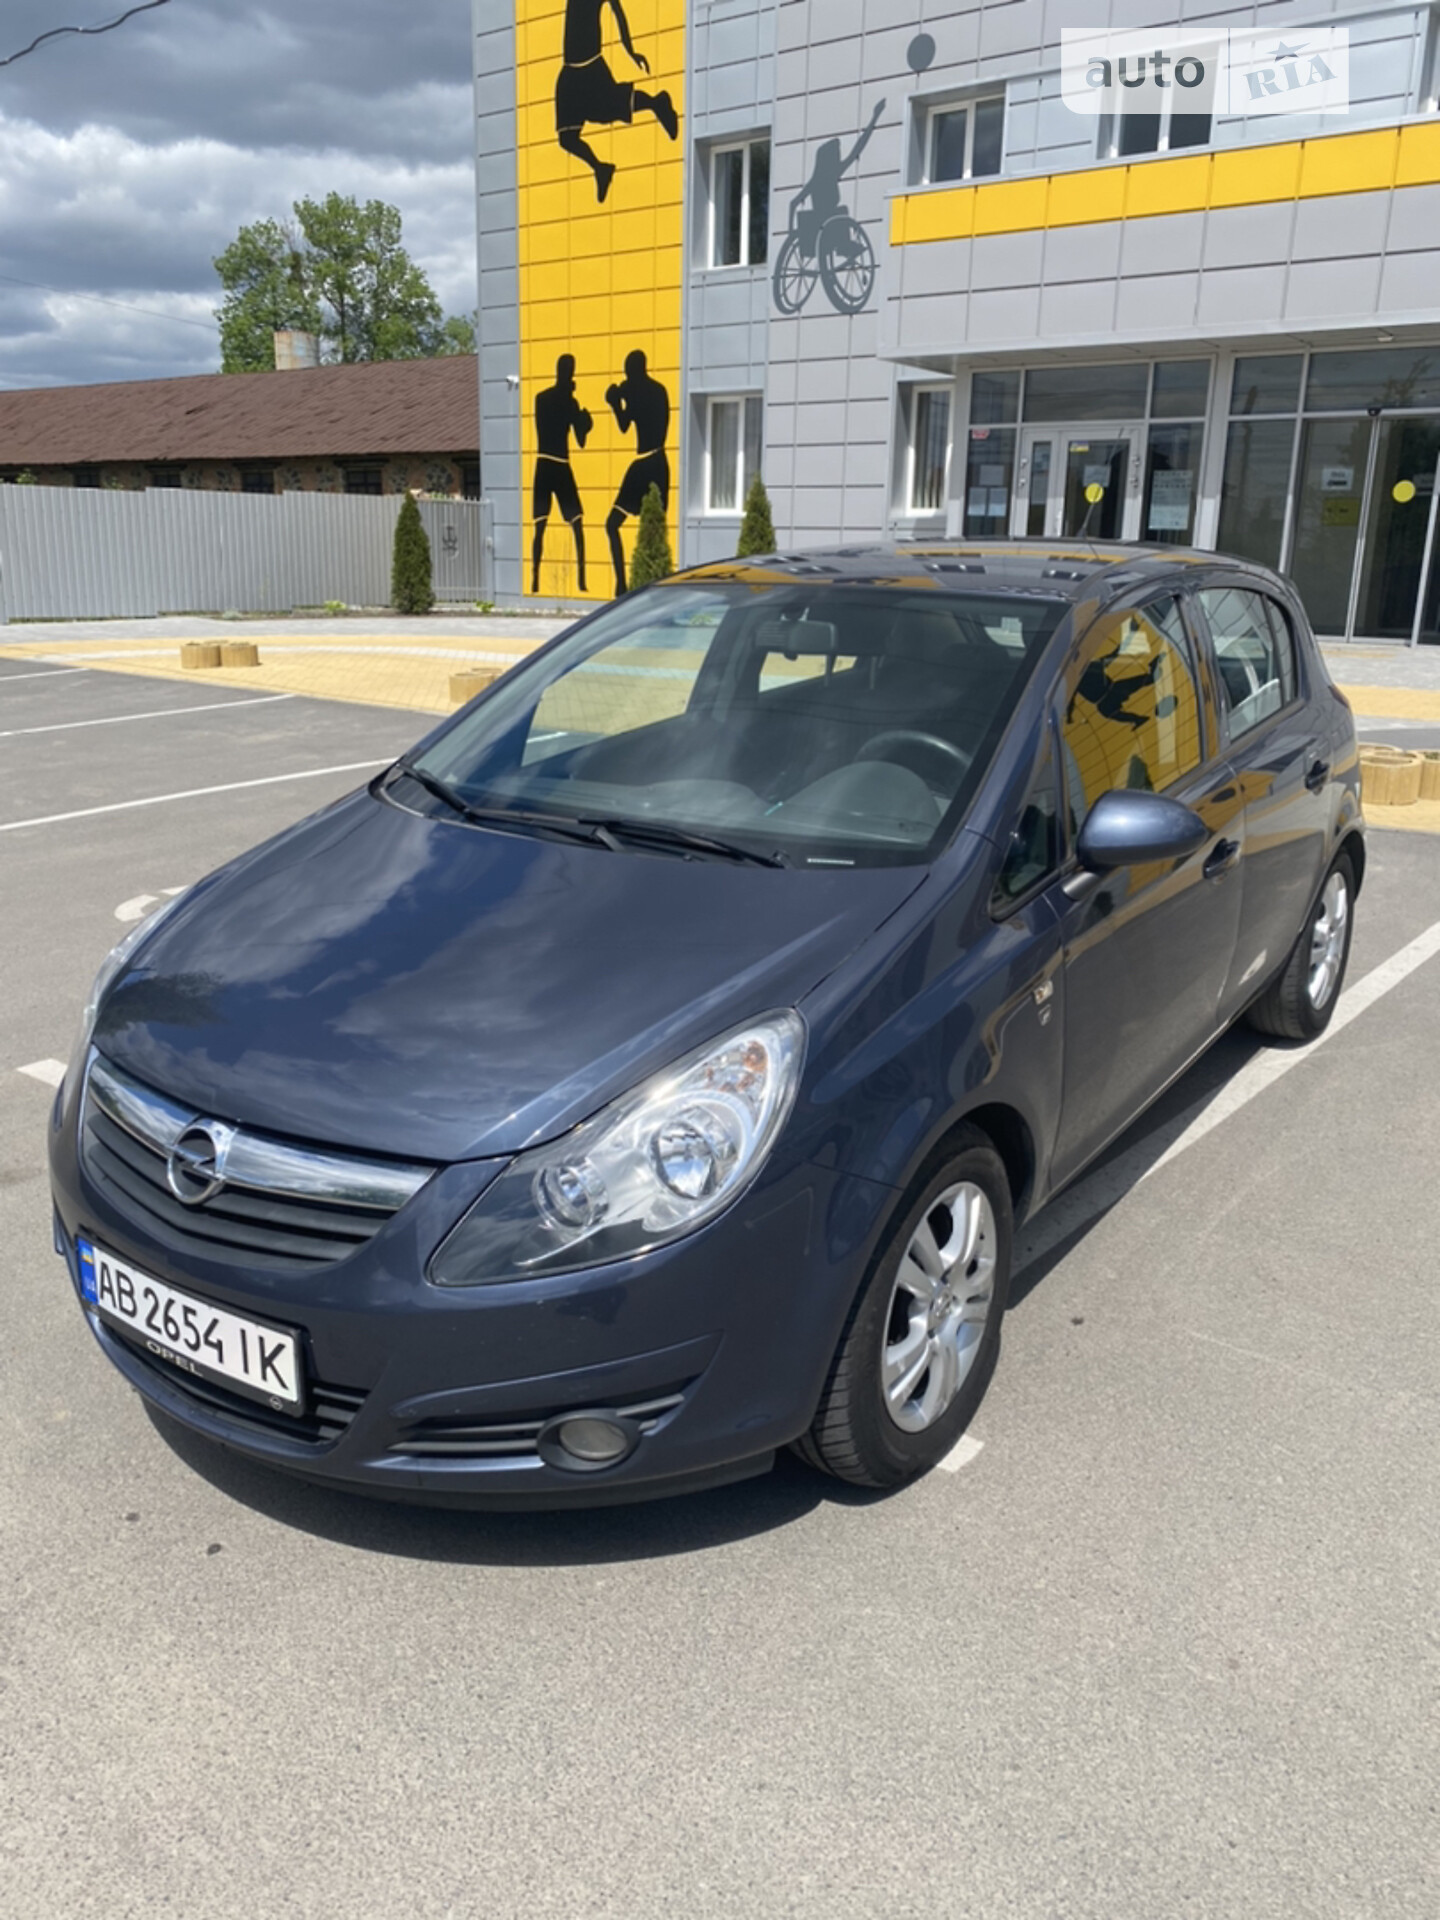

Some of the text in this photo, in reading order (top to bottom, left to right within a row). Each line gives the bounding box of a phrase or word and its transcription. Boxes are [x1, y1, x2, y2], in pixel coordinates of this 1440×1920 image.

[99, 1261, 289, 1390] AB 2654 IK
[146, 1340, 203, 1377] OPEL
